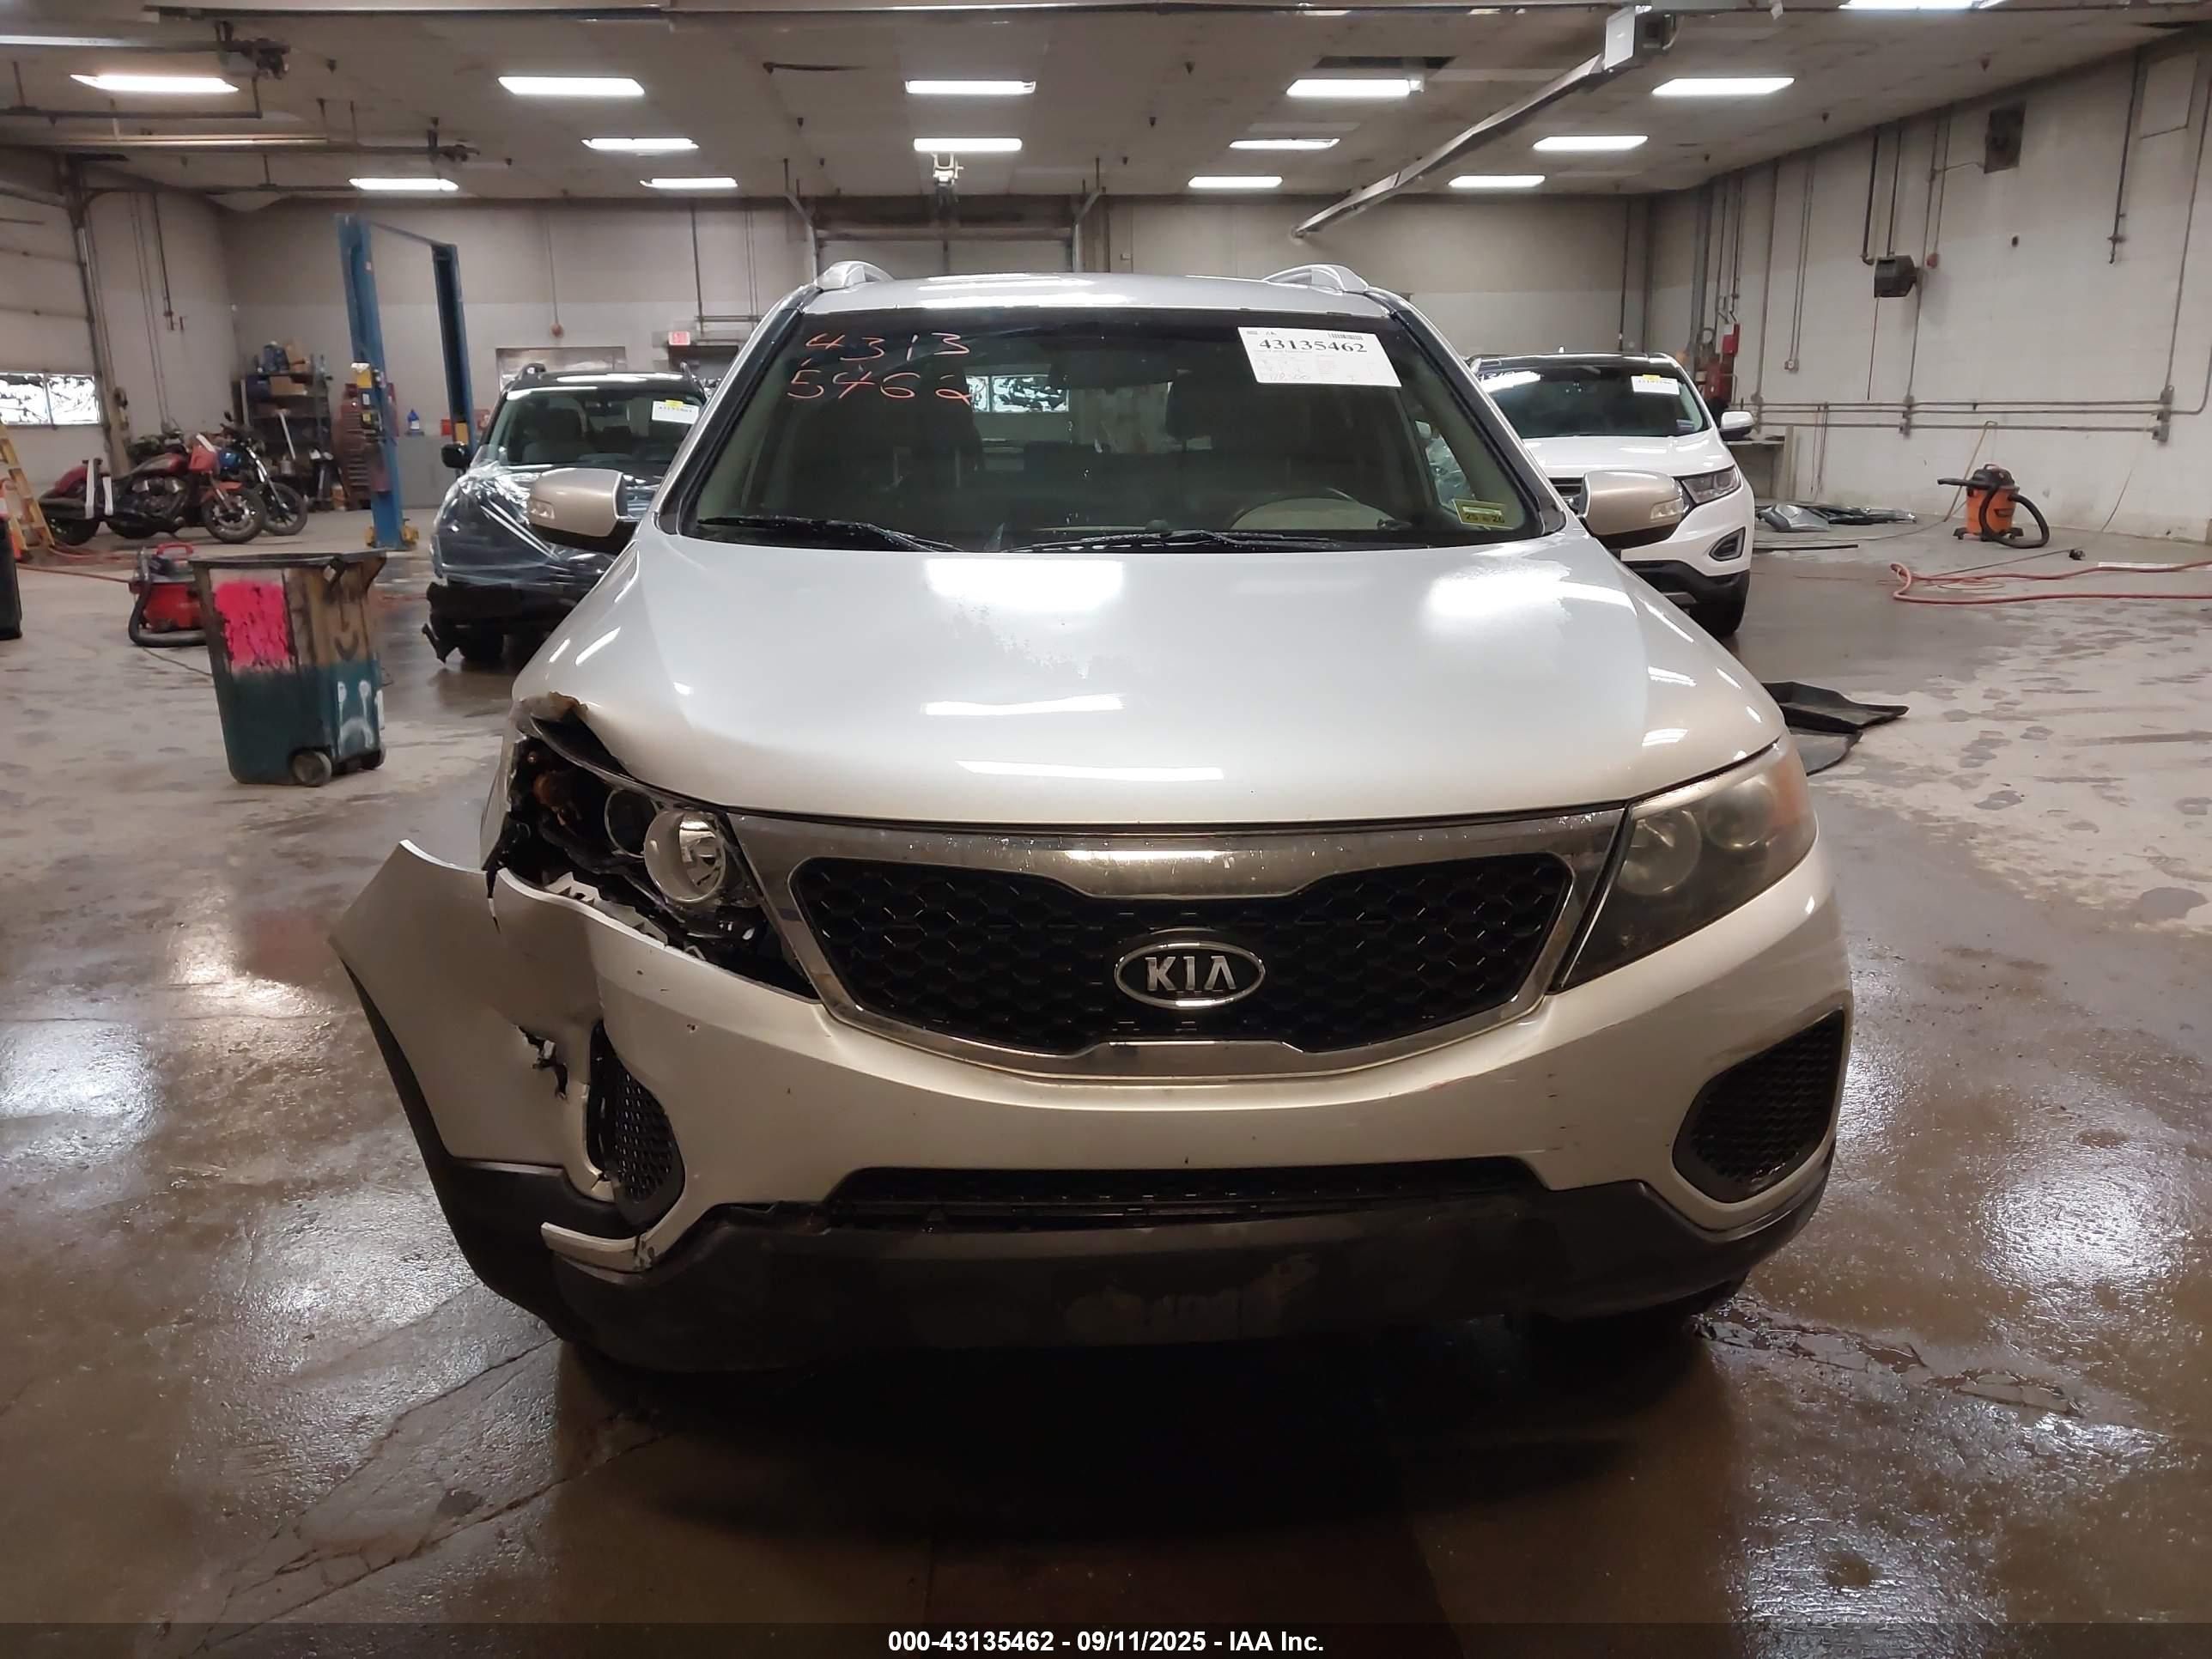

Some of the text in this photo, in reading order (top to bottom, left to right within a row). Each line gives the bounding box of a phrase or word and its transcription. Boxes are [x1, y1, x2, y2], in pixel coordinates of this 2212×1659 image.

[805, 332, 970, 361] 4313
[1259, 338, 1368, 353] 43135462
[1145, 955, 1237, 991] KIA
